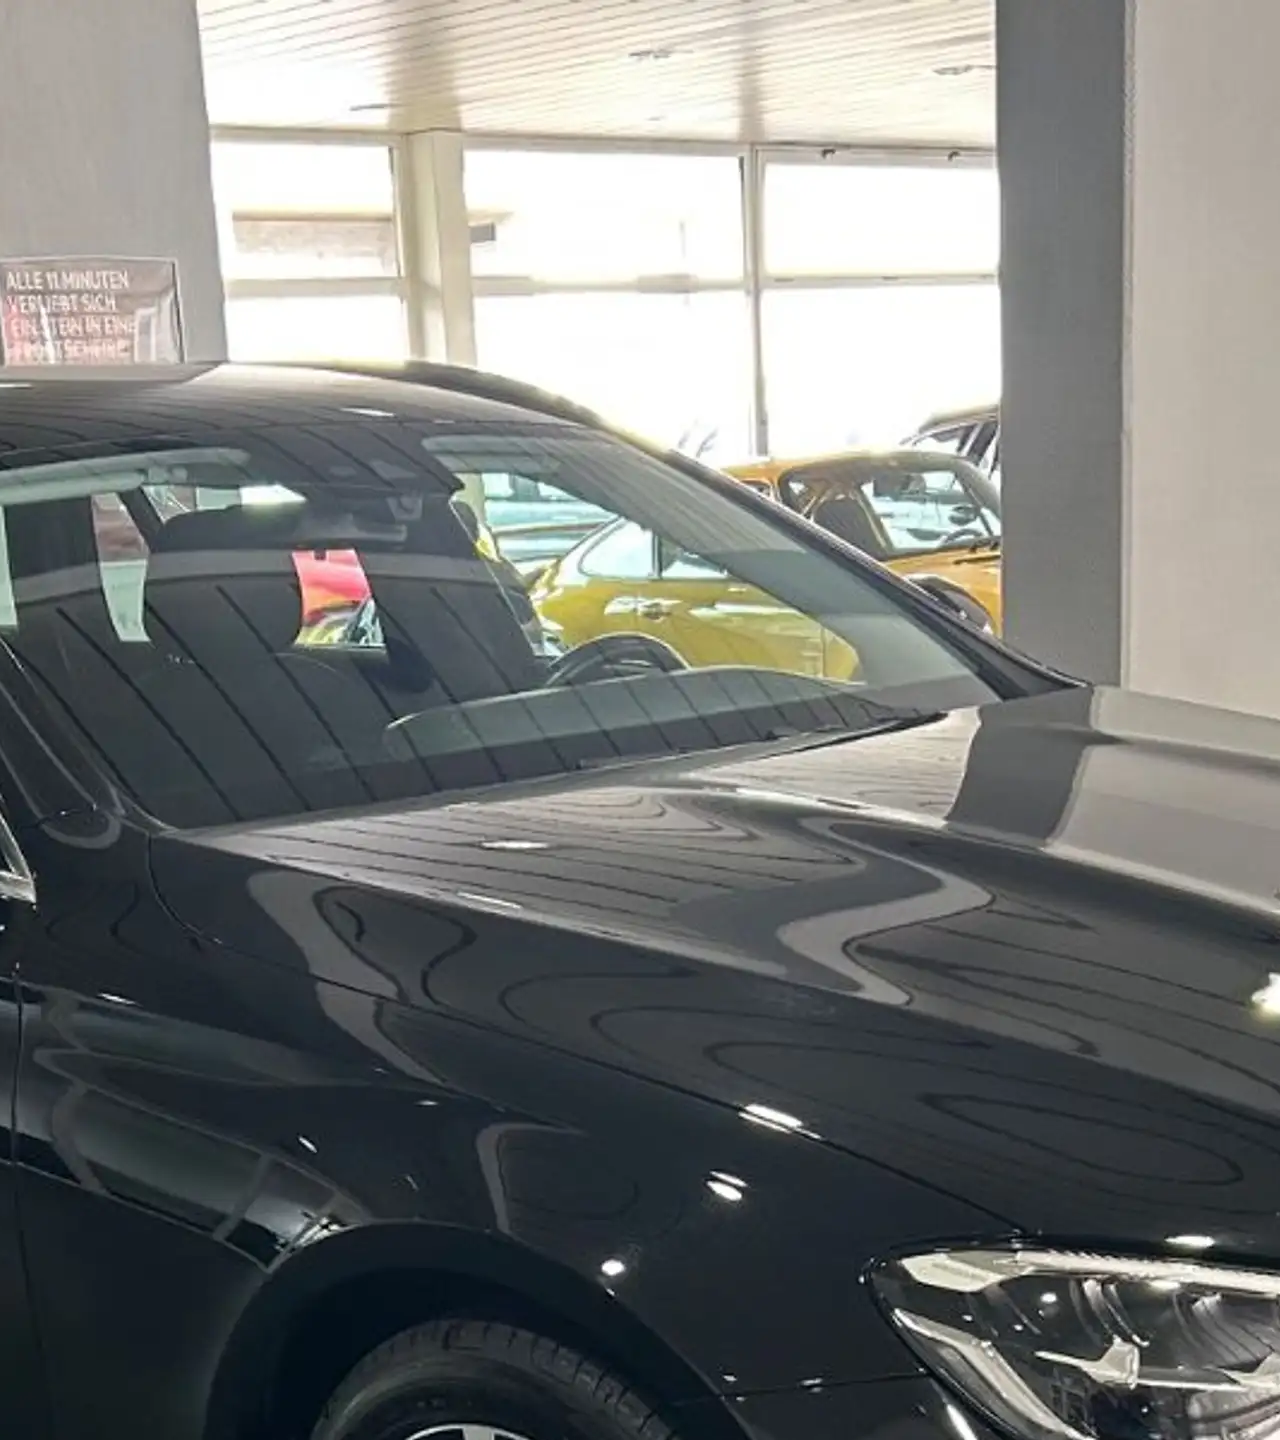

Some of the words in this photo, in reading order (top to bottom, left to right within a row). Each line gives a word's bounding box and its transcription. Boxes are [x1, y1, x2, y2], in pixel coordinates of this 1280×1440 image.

[6, 271, 43, 291] ALLE
[62, 269, 130, 290] MINUTEN
[81, 293, 116, 312] SICH
